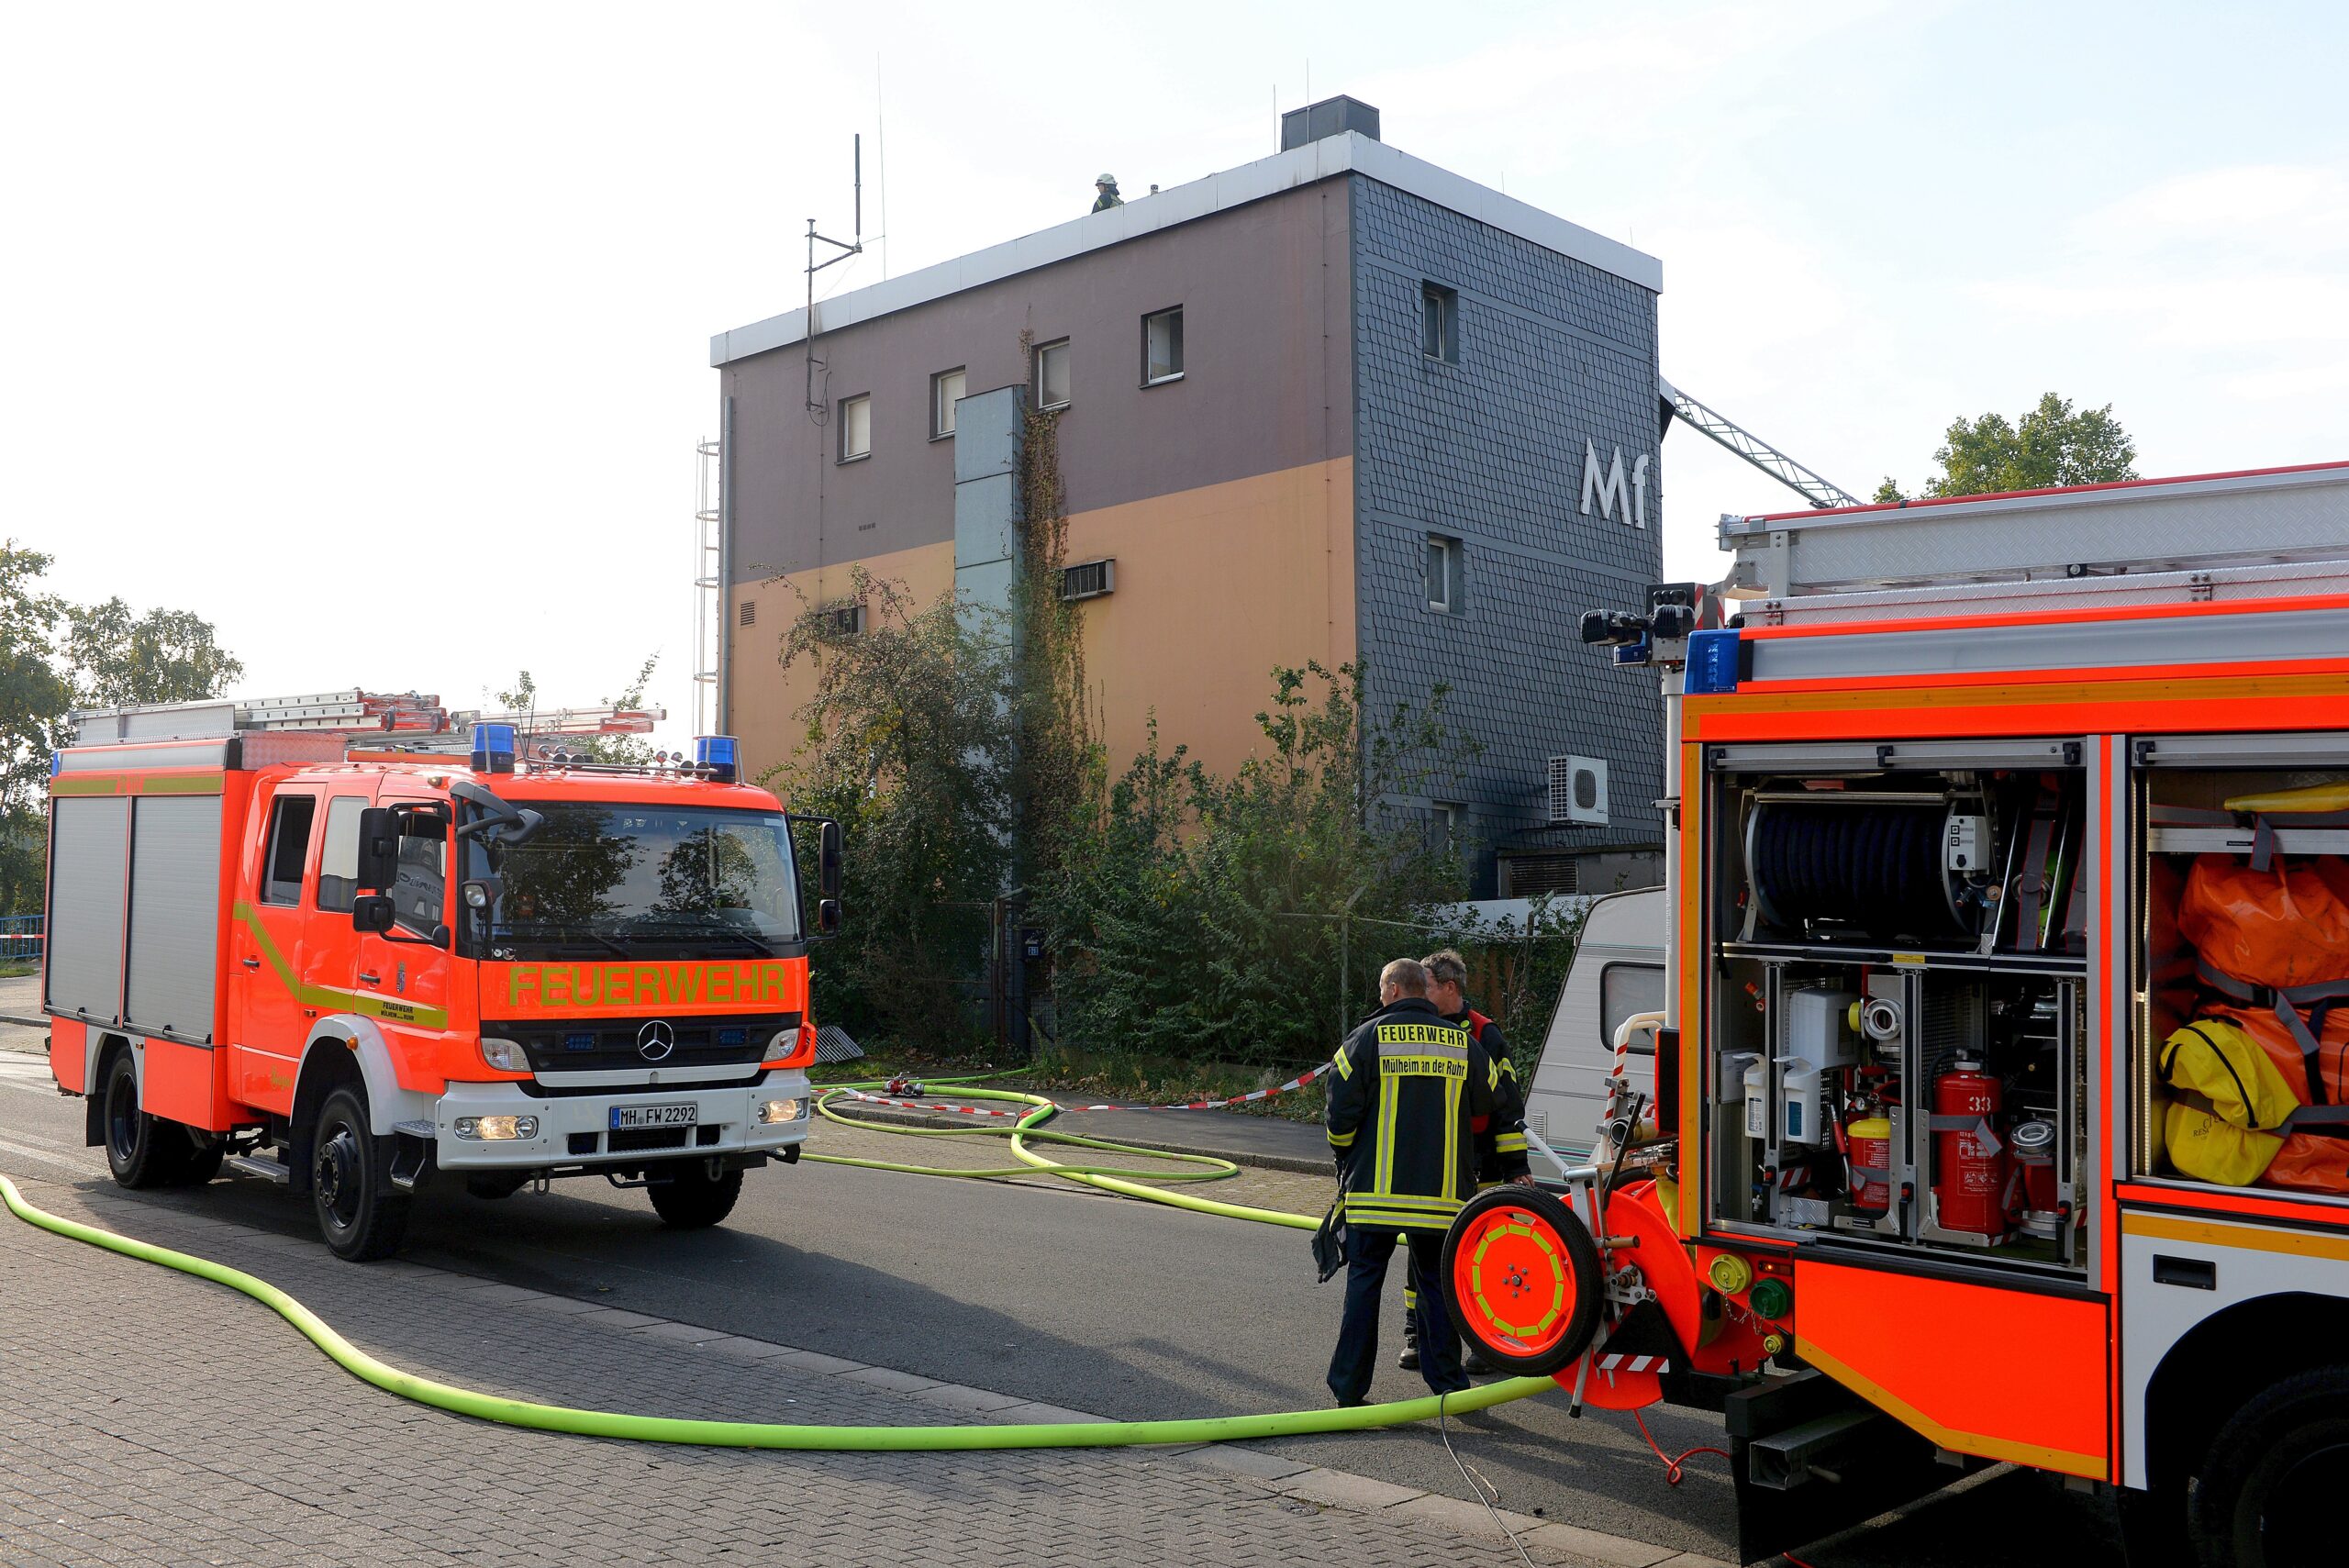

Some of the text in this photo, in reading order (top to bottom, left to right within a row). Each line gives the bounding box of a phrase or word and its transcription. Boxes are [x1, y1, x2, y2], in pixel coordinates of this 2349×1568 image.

[1580, 437, 1649, 529] Mf
[509, 964, 785, 1006] FEUERWEHR
[384, 1002, 413, 1014] FEUERWEHR
[1380, 1026, 1464, 1046] FEUERWEHR
[1382, 1058, 1465, 1076] Mülheim an der Ruhr
[621, 1109, 637, 1125] MH
[646, 1108, 662, 1123] FW
[664, 1106, 696, 1123] 2292
